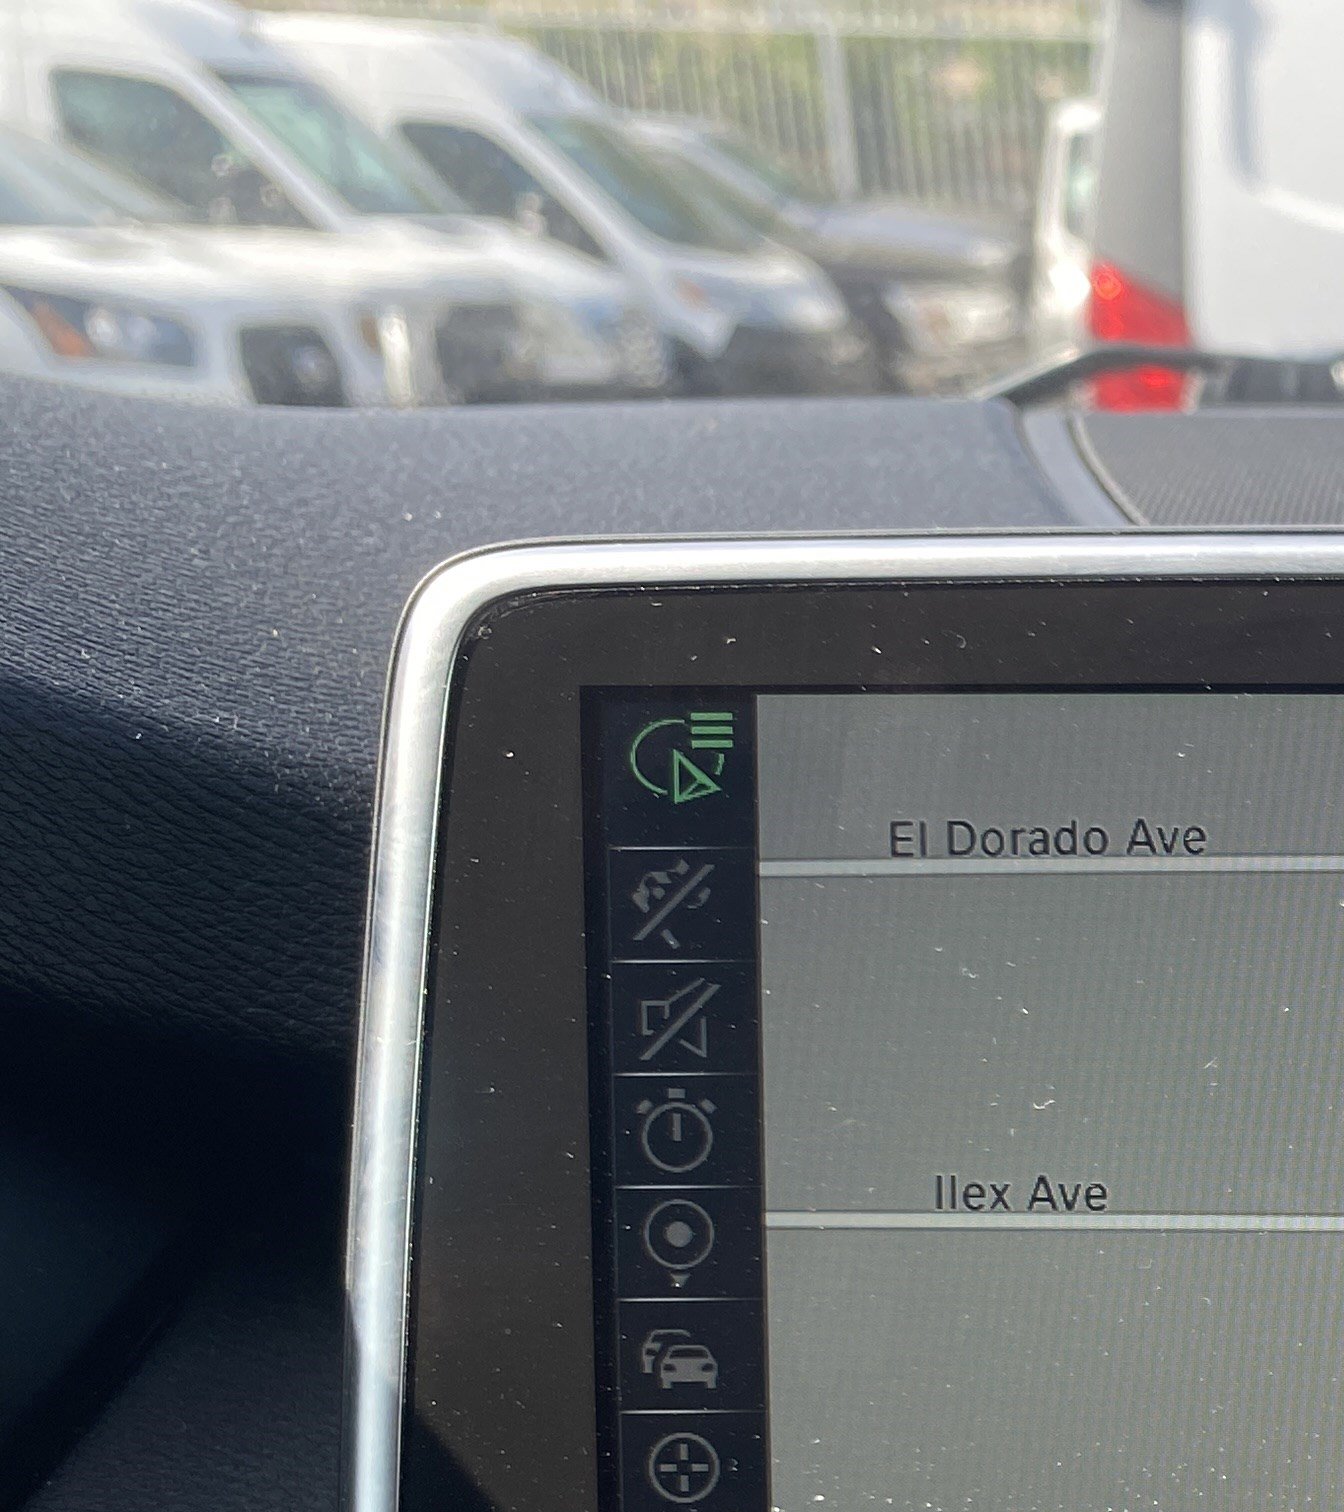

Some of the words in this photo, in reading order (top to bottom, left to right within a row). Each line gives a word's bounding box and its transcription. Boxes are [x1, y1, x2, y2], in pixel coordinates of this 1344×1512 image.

[889, 820, 927, 857] El
[946, 819, 1109, 857] Dorado
[1126, 819, 1208, 856] Ave
[934, 1175, 1010, 1212] Ilex
[1027, 1175, 1109, 1212] Ave
